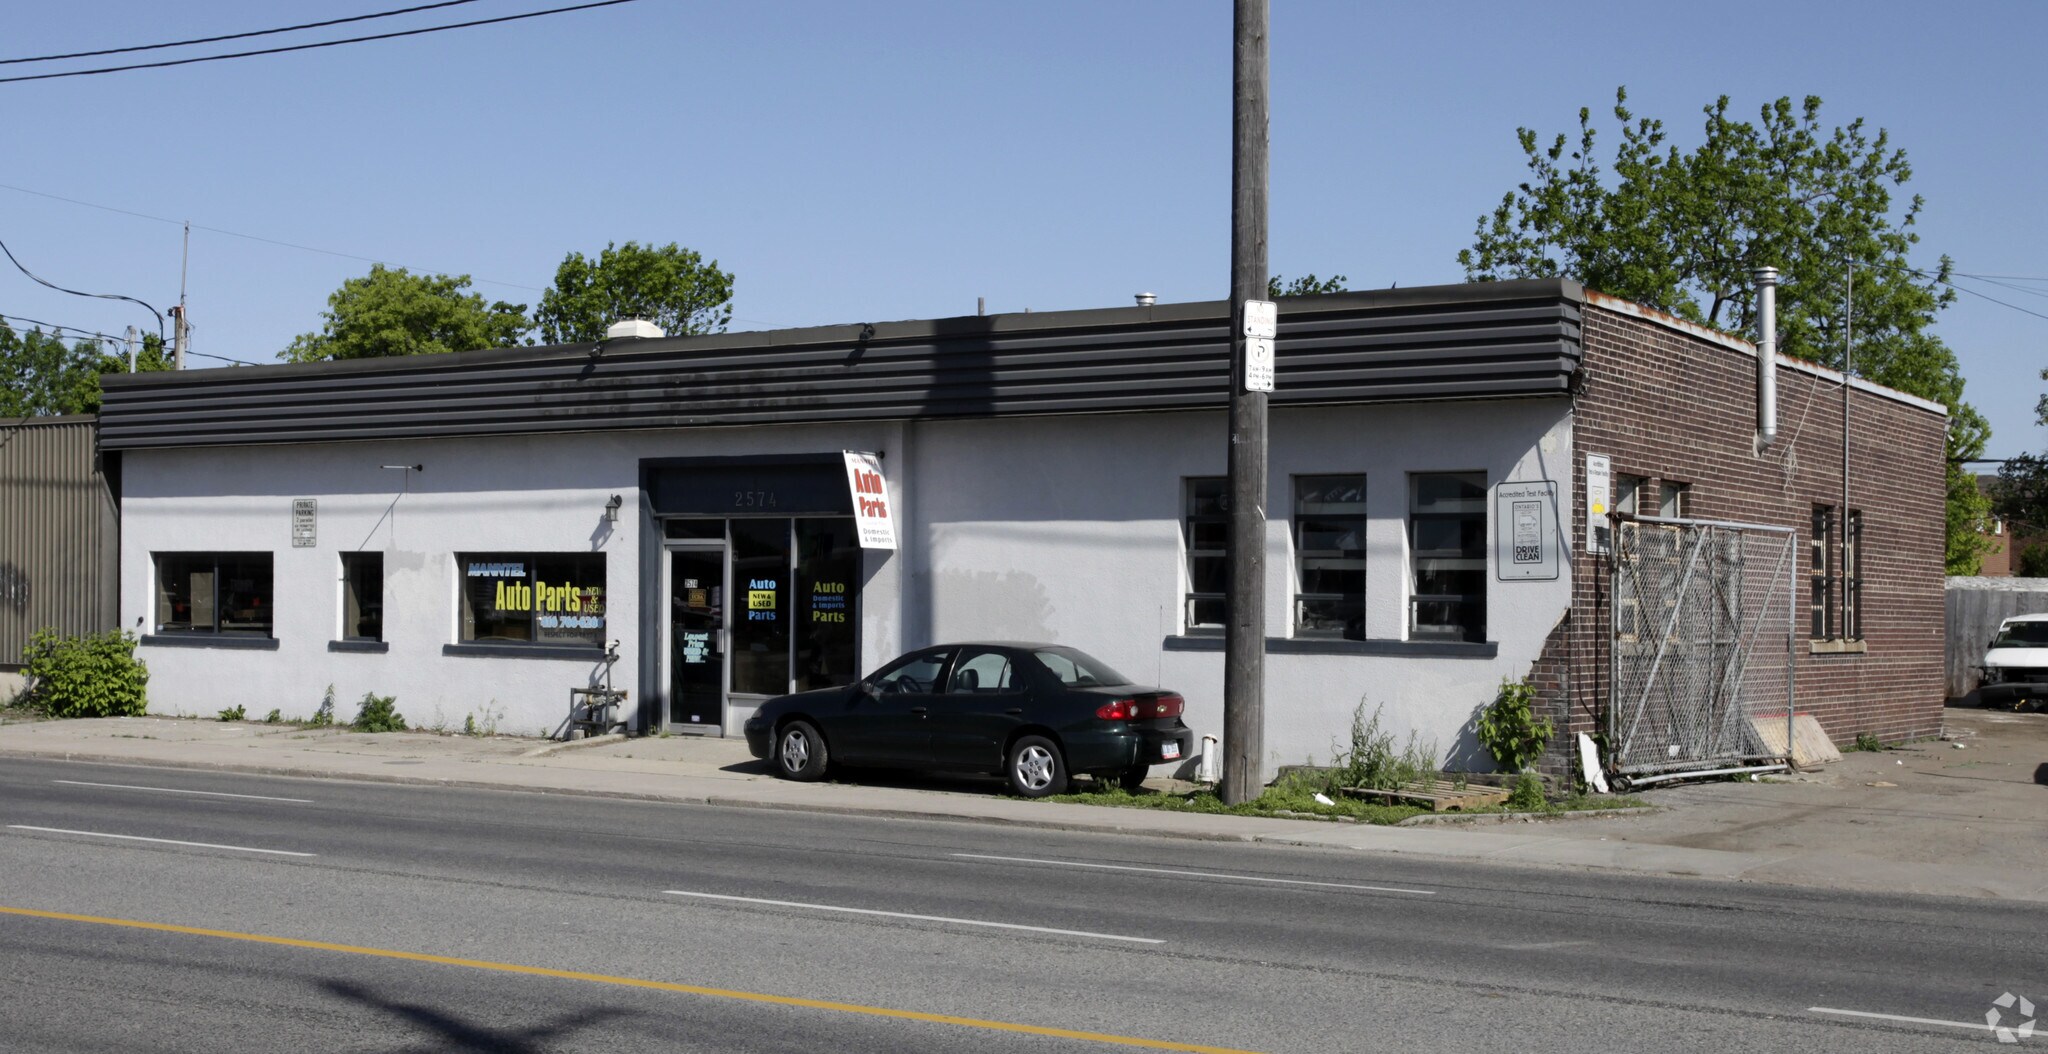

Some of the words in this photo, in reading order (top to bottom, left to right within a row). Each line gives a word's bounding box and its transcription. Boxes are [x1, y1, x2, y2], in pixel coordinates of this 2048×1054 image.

[854, 468, 882, 494] Auto
[735, 491, 776, 507] 2574
[858, 496, 887, 518] Parts
[749, 579, 776, 589] Auto
[813, 582, 844, 593] Auto
[496, 581, 531, 610] Auto
[536, 582, 580, 612] Parts
[586, 586, 603, 596] NEW
[584, 604, 604, 613] USED
[748, 611, 776, 620] Parts
[813, 611, 844, 622] Parts
